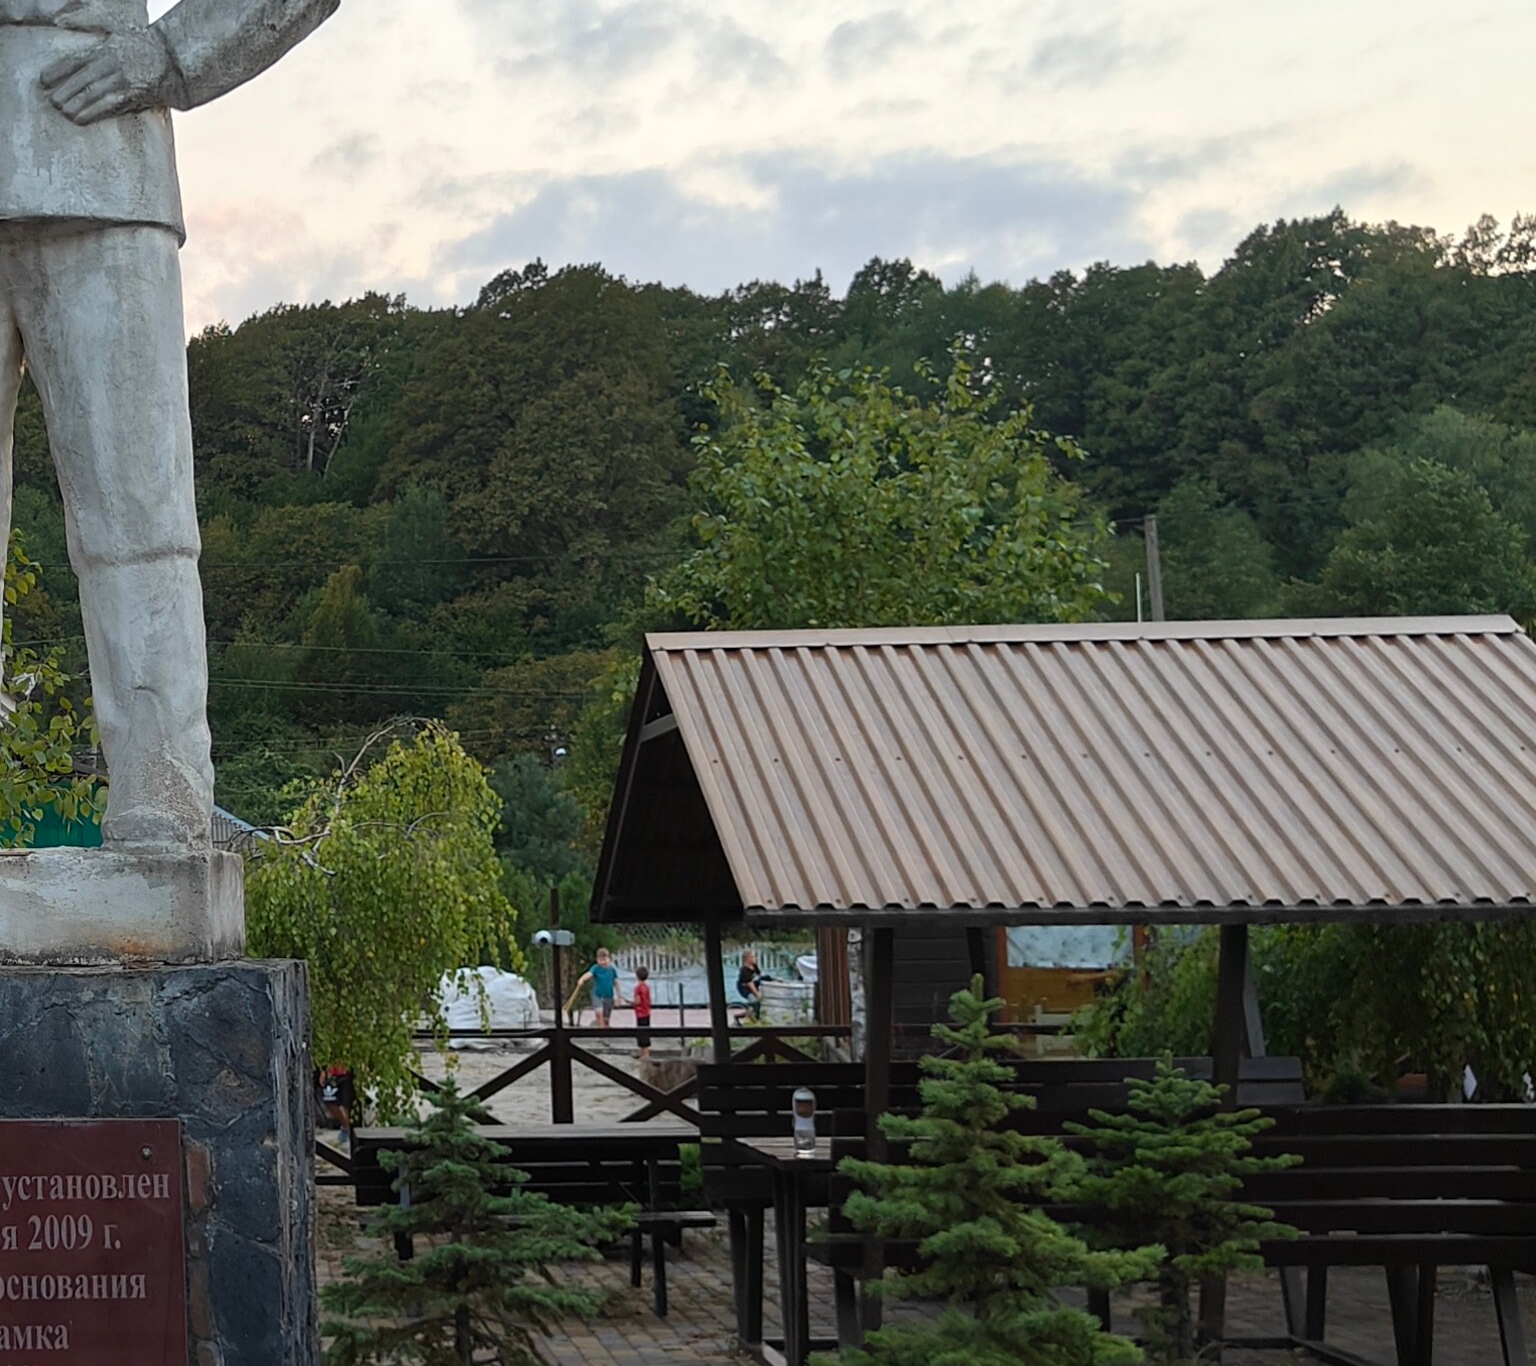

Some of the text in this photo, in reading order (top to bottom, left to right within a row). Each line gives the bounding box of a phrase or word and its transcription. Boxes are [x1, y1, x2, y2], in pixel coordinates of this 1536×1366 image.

[2, 1173, 170, 1210] установлен
[27, 1214, 93, 1250] 2009
[103, 1224, 122, 1250] г.
